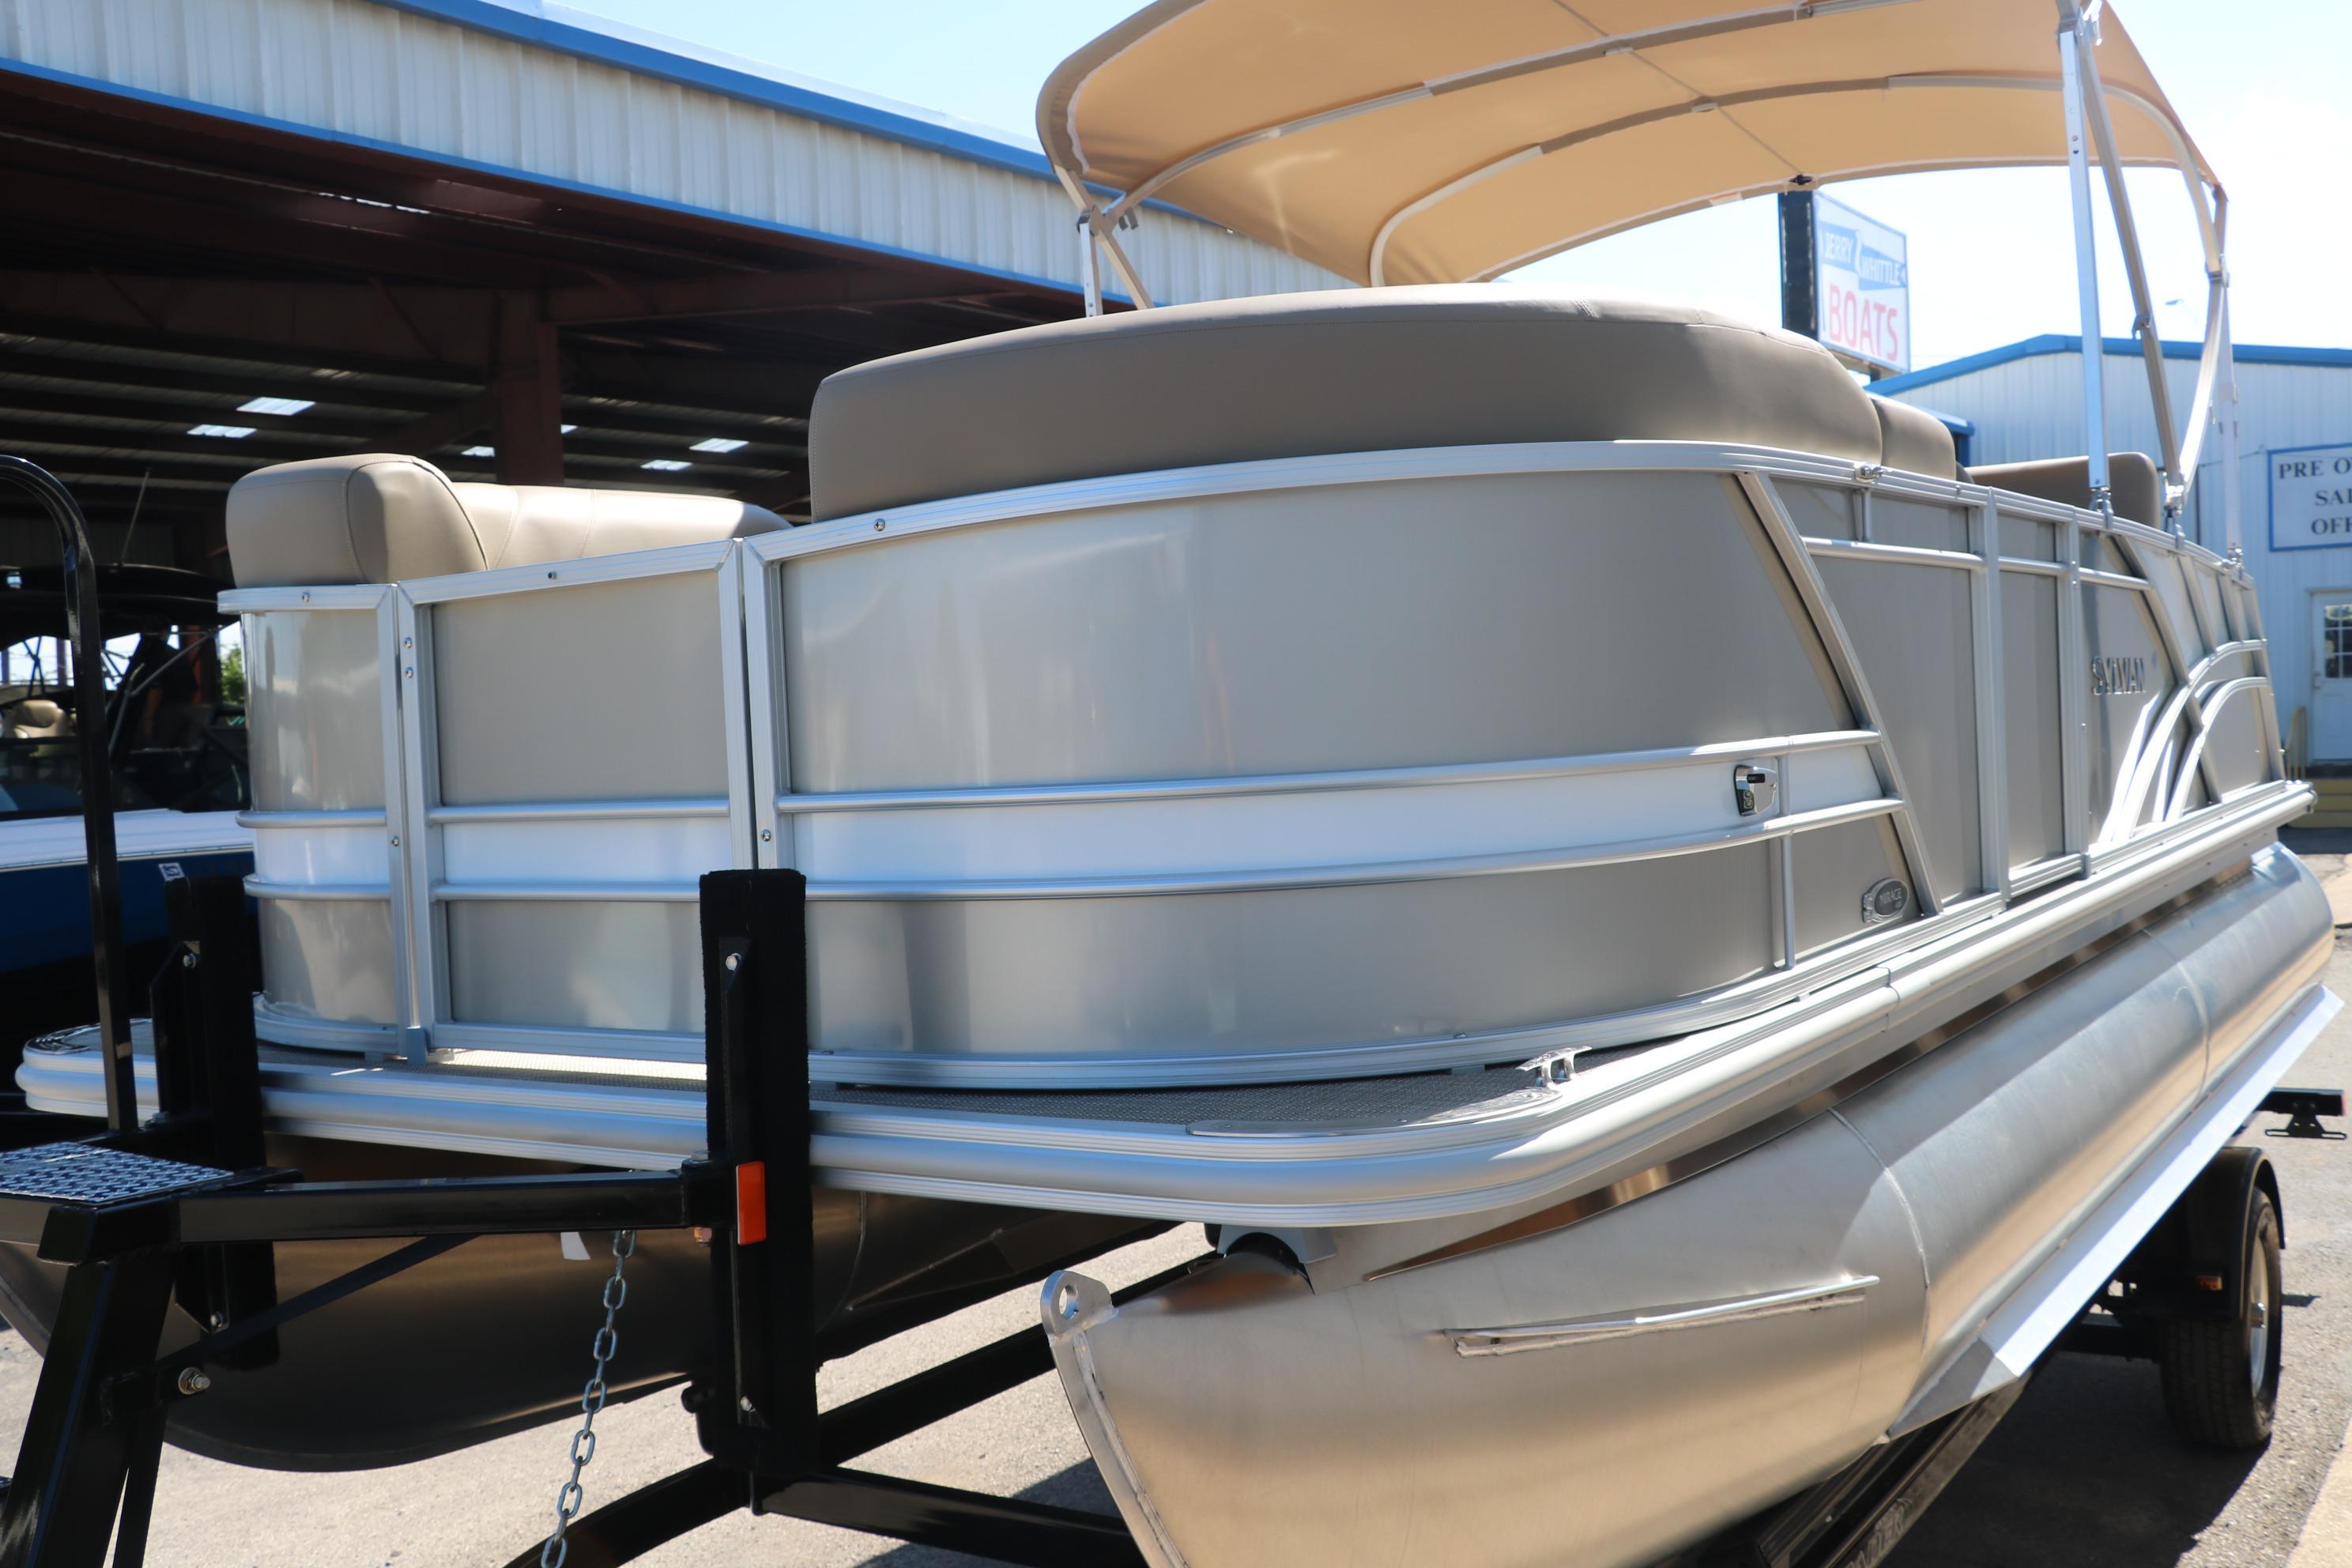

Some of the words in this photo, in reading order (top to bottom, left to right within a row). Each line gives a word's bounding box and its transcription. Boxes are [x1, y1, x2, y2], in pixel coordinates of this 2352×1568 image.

[1824, 232, 1854, 263] JERRY
[1860, 255, 1901, 285] WHITTLE
[1829, 284, 1898, 361] BOATS
[2279, 460, 2324, 479] PRE
[2334, 457, 2352, 474] O
[2091, 656, 2147, 695] SYLVAN
